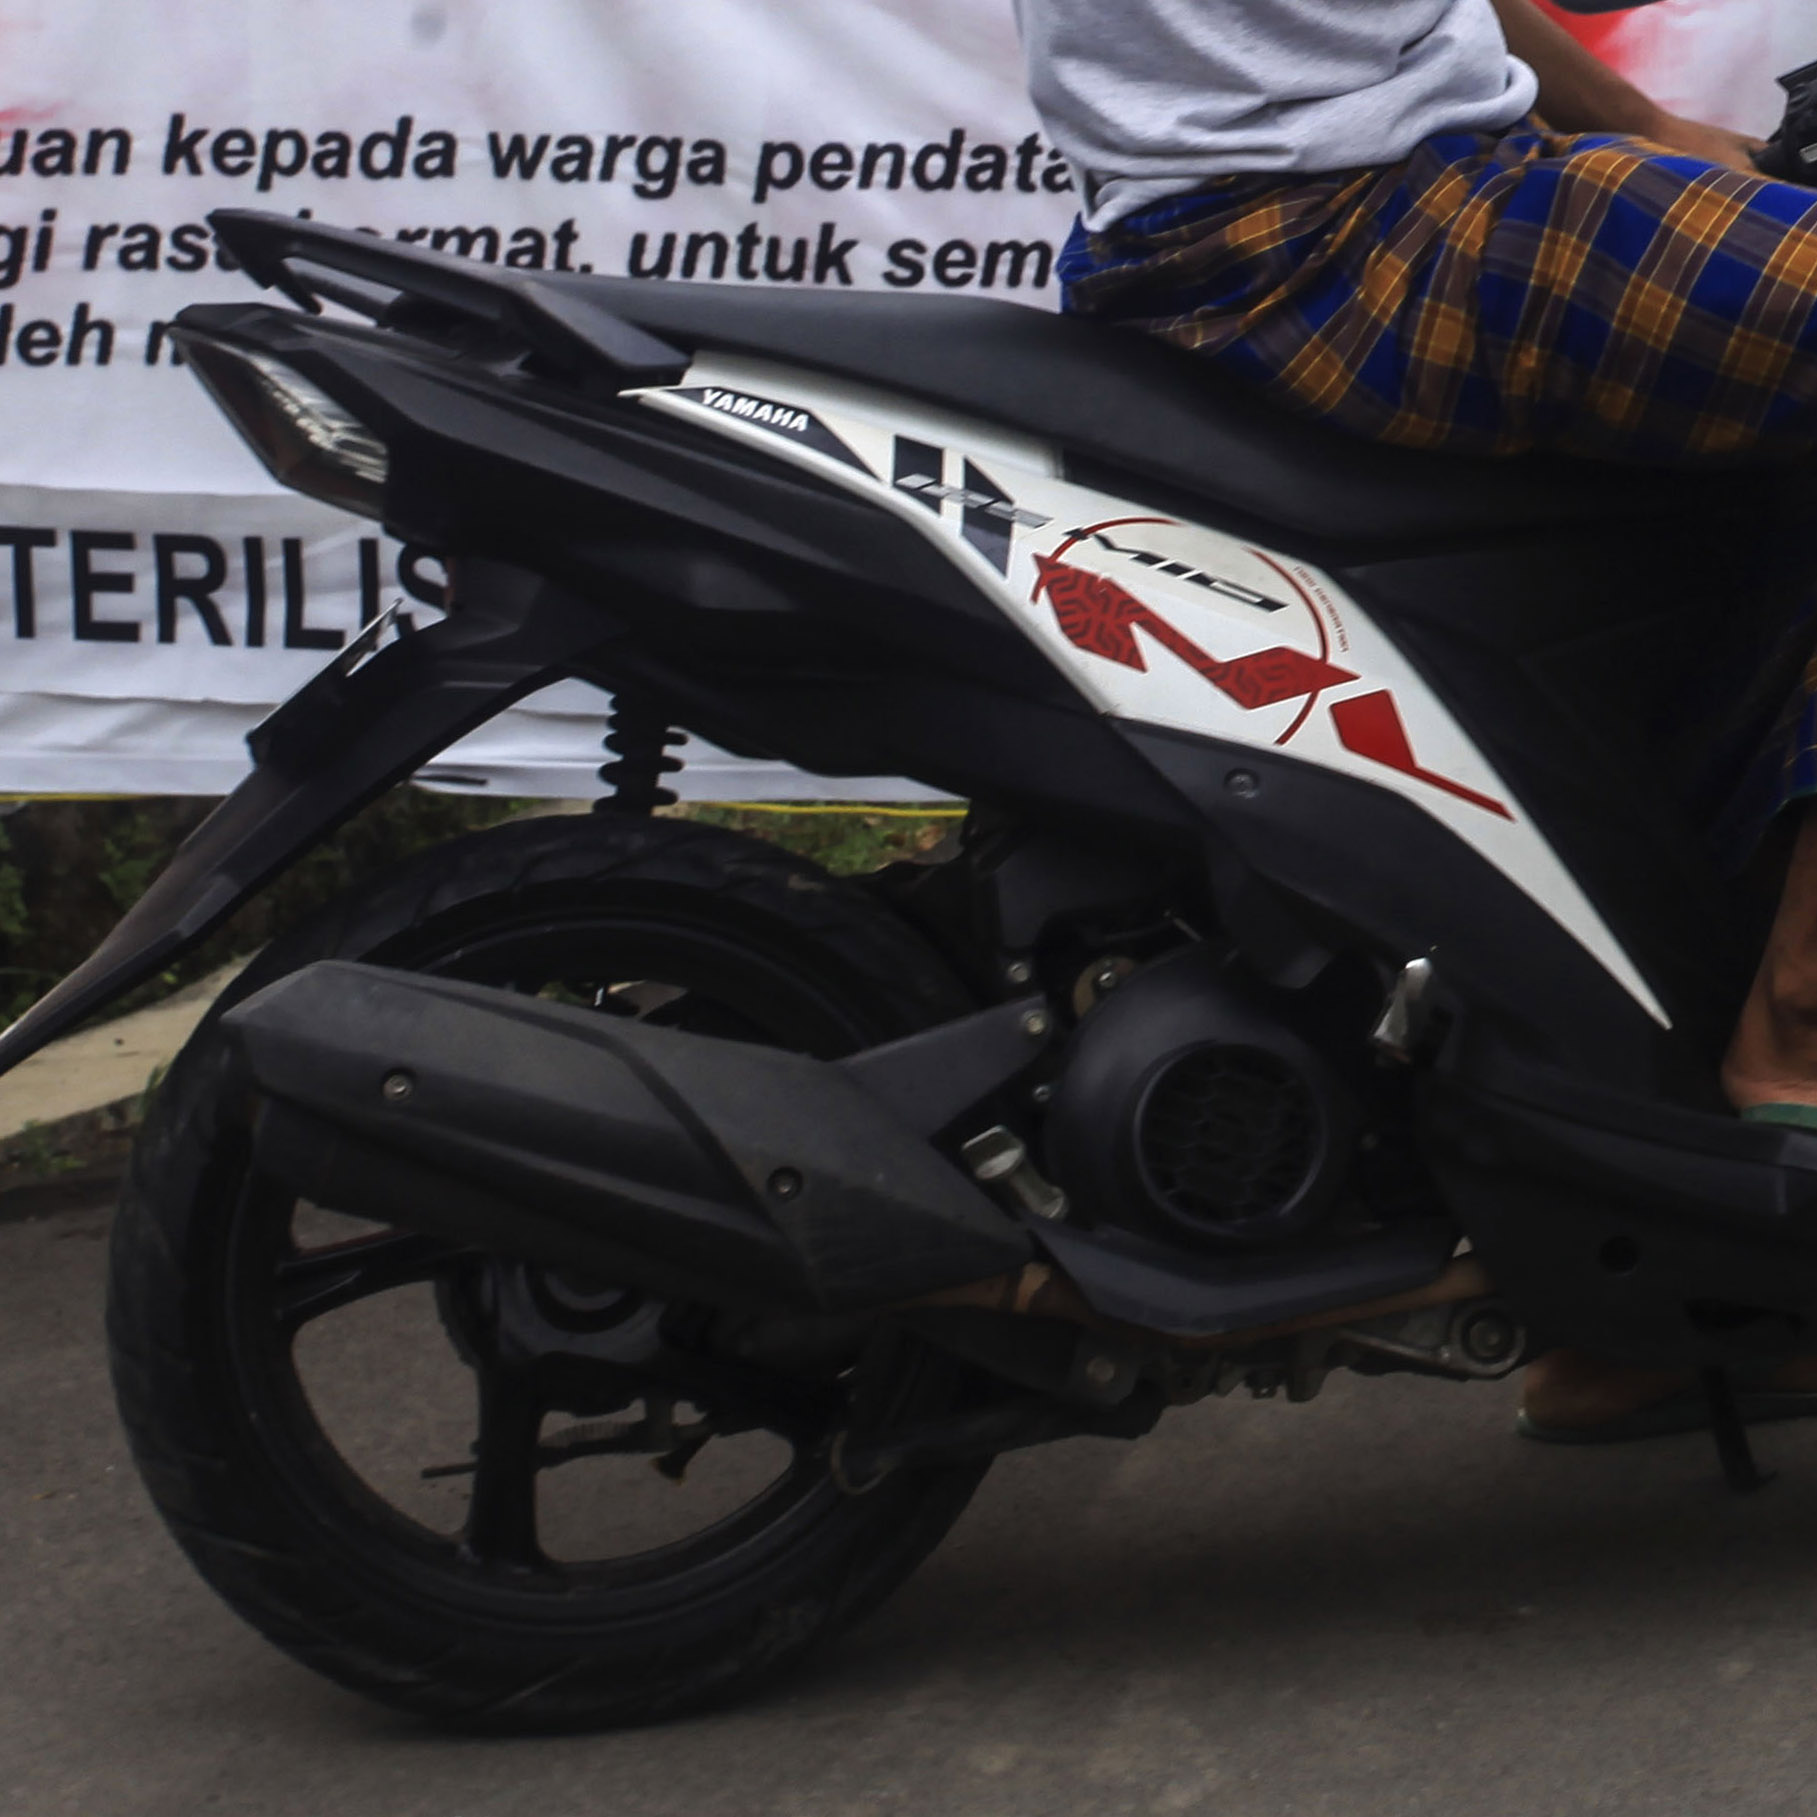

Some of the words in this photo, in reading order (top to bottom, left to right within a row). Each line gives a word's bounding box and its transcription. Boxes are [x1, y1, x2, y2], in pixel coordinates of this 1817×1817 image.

[162, 113, 457, 192] kepada
[487, 132, 727, 200] warga
[627, 222, 858, 285] untuk
[700, 388, 809, 433] YAMAHA
